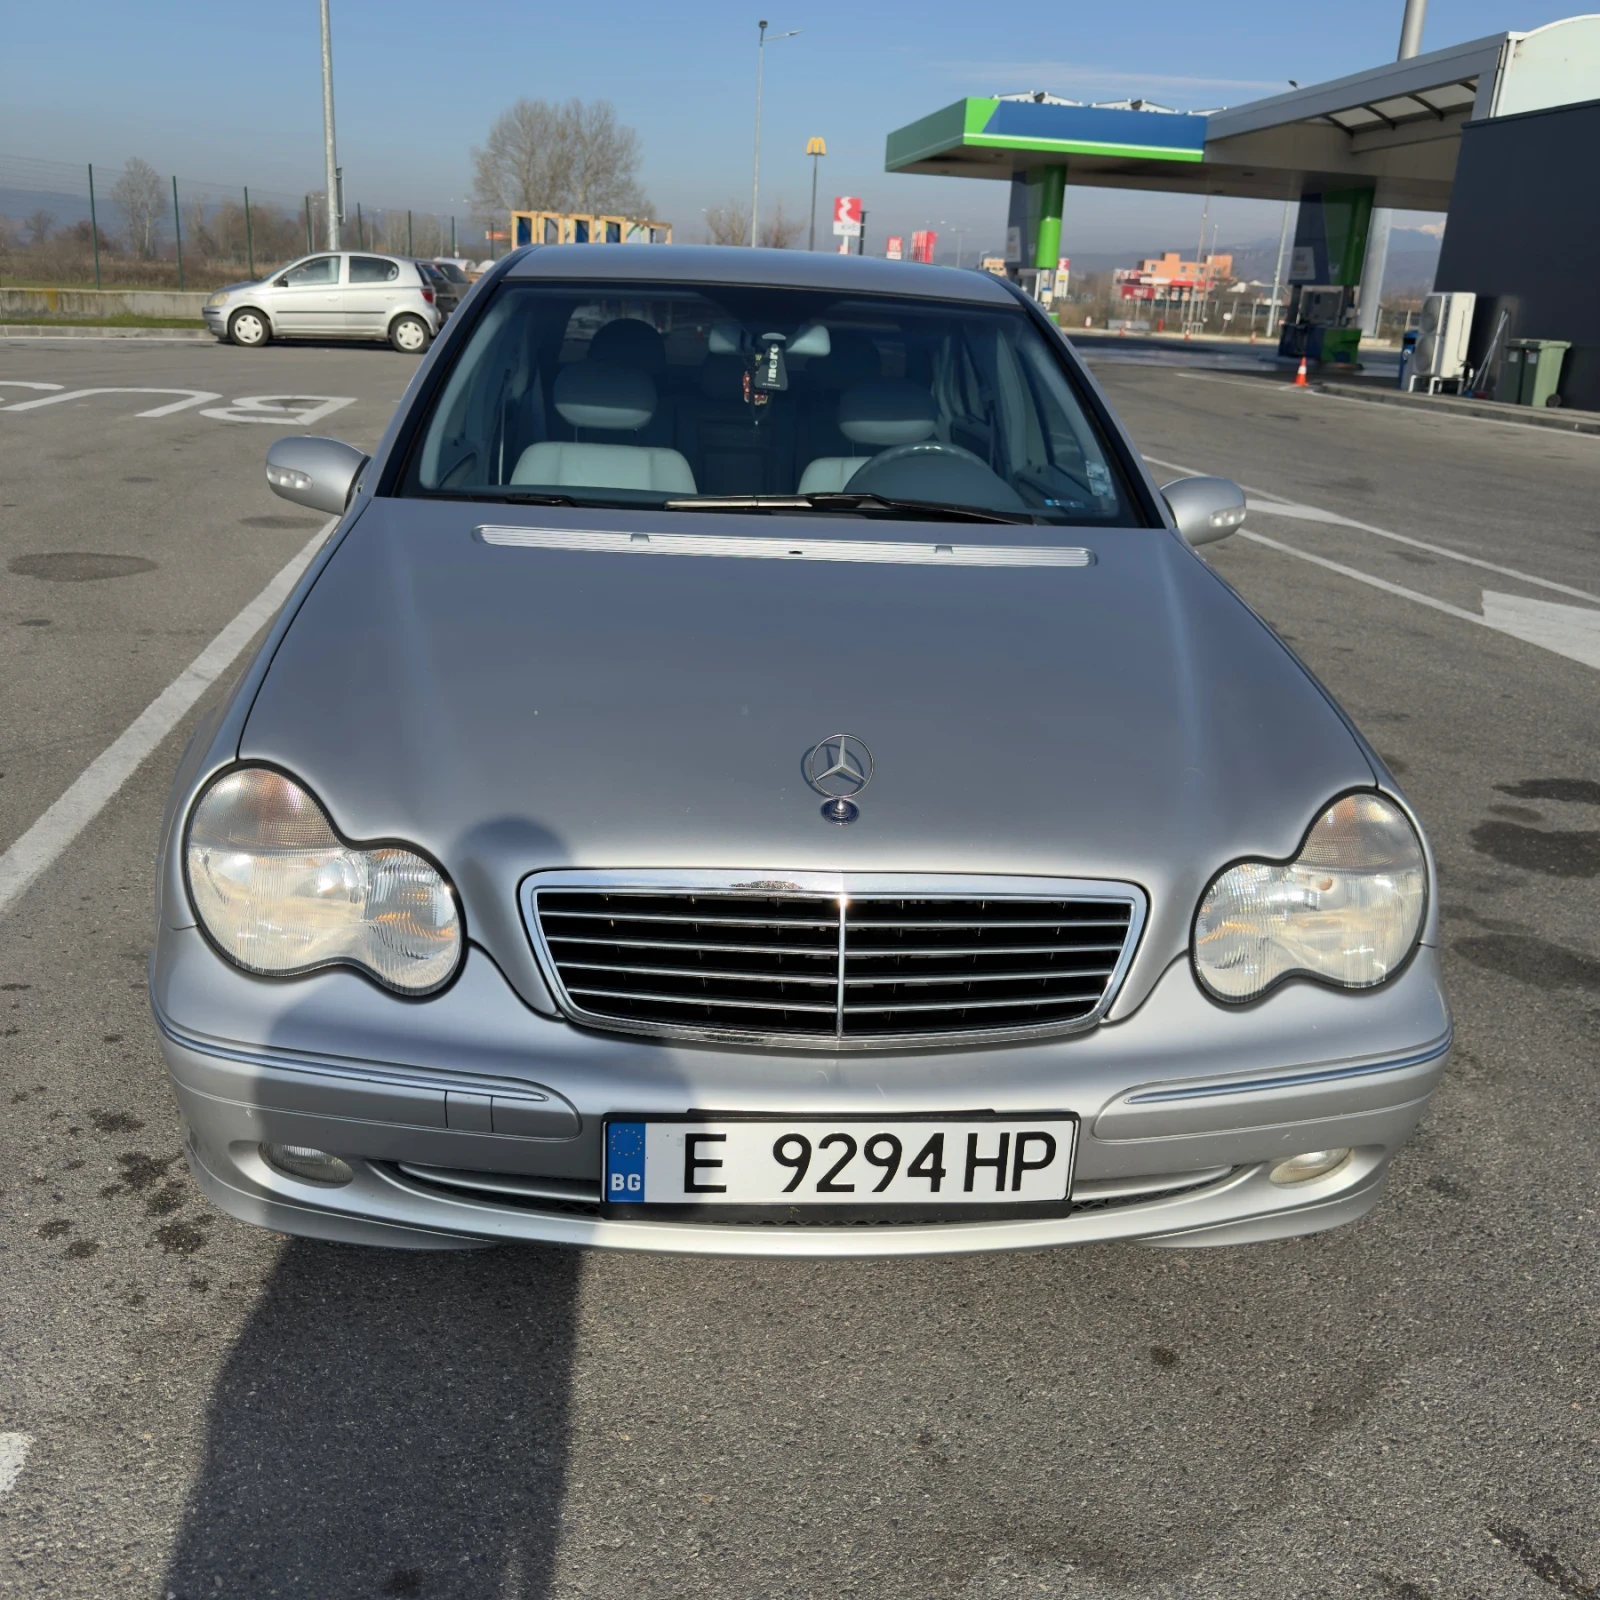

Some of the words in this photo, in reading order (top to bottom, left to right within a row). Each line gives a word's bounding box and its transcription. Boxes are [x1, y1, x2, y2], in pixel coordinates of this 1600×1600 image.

[0, 381, 358, 425] BU
[611, 1173, 641, 1191] BG
[684, 1133, 727, 1193] E
[772, 1132, 947, 1193] 9294
[963, 1131, 1057, 1192] HP
